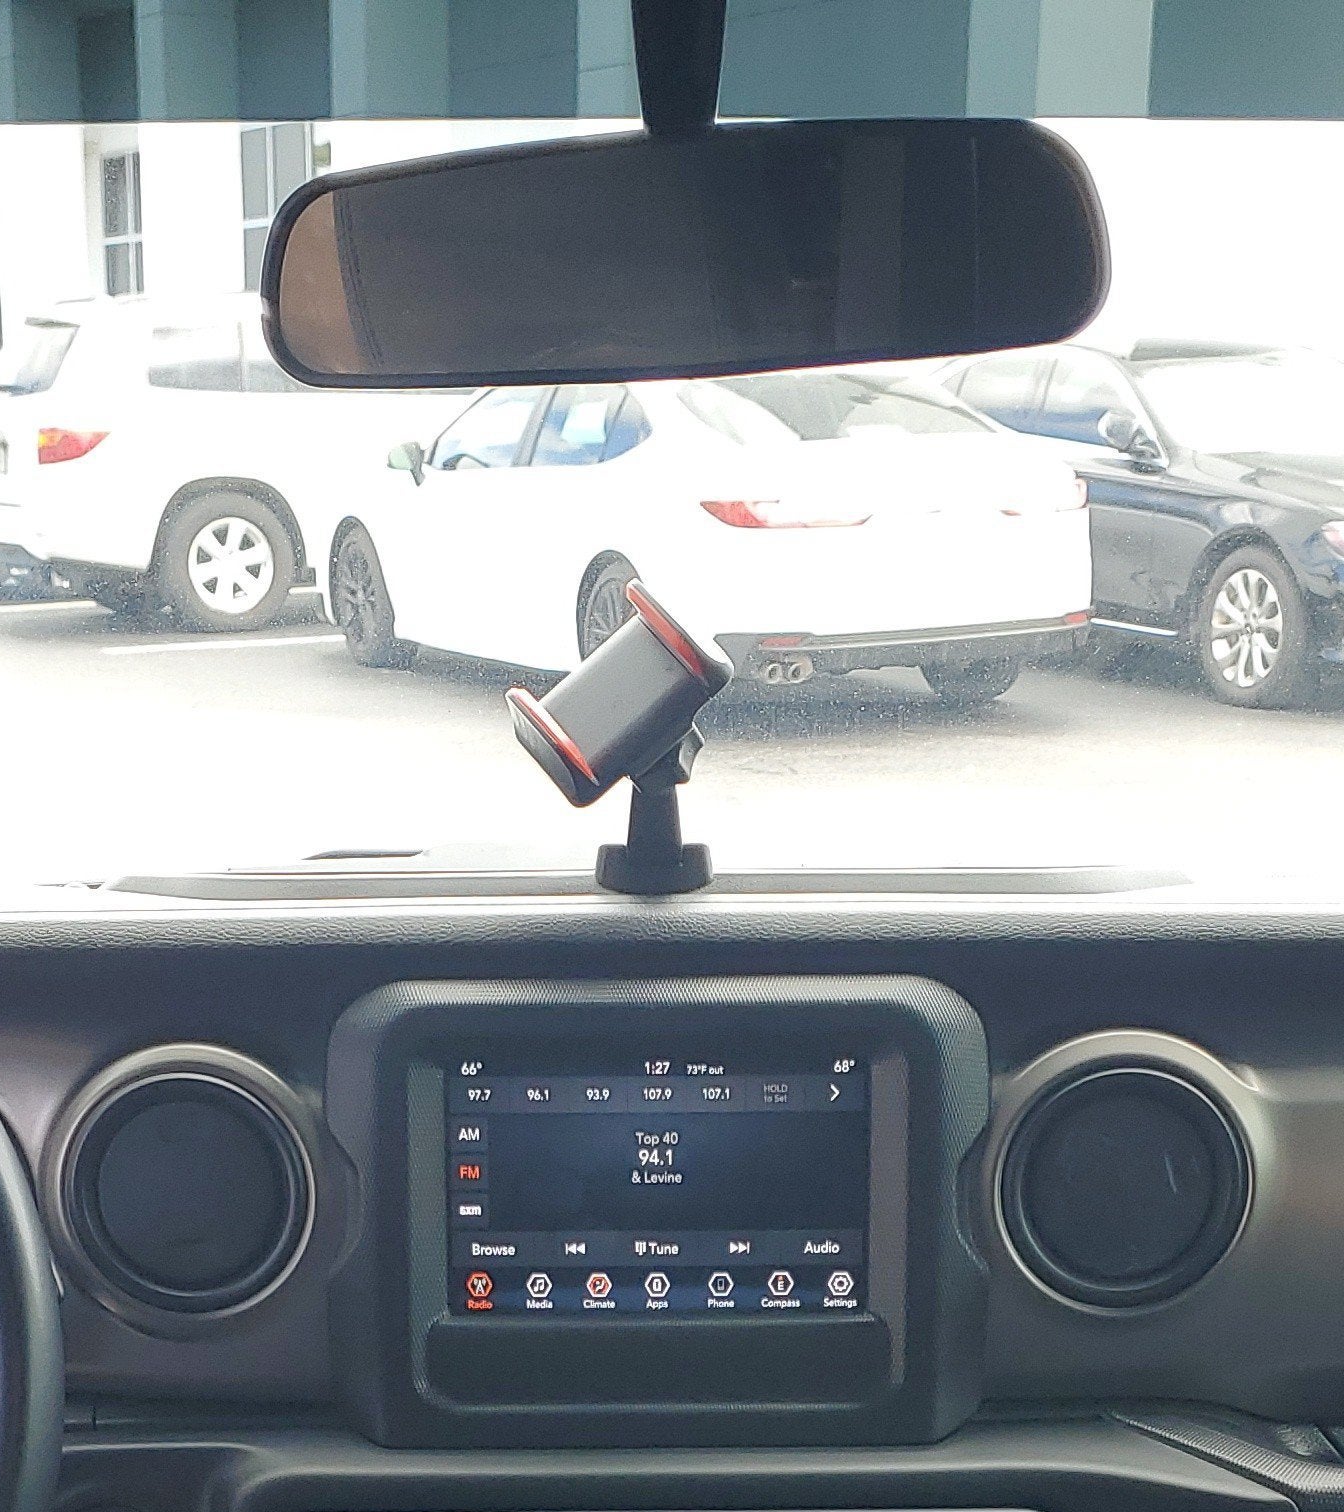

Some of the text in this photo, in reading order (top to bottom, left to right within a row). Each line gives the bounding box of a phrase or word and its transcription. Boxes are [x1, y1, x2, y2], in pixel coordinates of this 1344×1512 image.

[461, 1062, 482, 1076] 66°
[645, 1061, 670, 1075] 1:27
[687, 1064, 724, 1075] 73°F out
[834, 1059, 855, 1073] 68°
[468, 1089, 491, 1101] 97.7
[527, 1089, 550, 1101] 96.1
[586, 1089, 609, 1101] 93.9
[643, 1088, 672, 1100] 107.9
[702, 1088, 730, 1100] 107.1
[459, 1128, 480, 1142] AM
[636, 1132, 679, 1147] Top 40
[638, 1150, 674, 1166] 94.1
[459, 1166, 480, 1180] FM
[631, 1171, 642, 1184] &
[472, 1243, 516, 1257] Browse
[648, 1242, 679, 1256] Tune
[804, 1241, 840, 1255] Audio
[468, 1300, 493, 1310] Radio
[526, 1299, 553, 1309] Media
[583, 1299, 616, 1309] Climate
[646, 1299, 669, 1311] Apps
[707, 1298, 735, 1309] Phone
[761, 1298, 801, 1309] Compass
[823, 1297, 858, 1310] Settings
